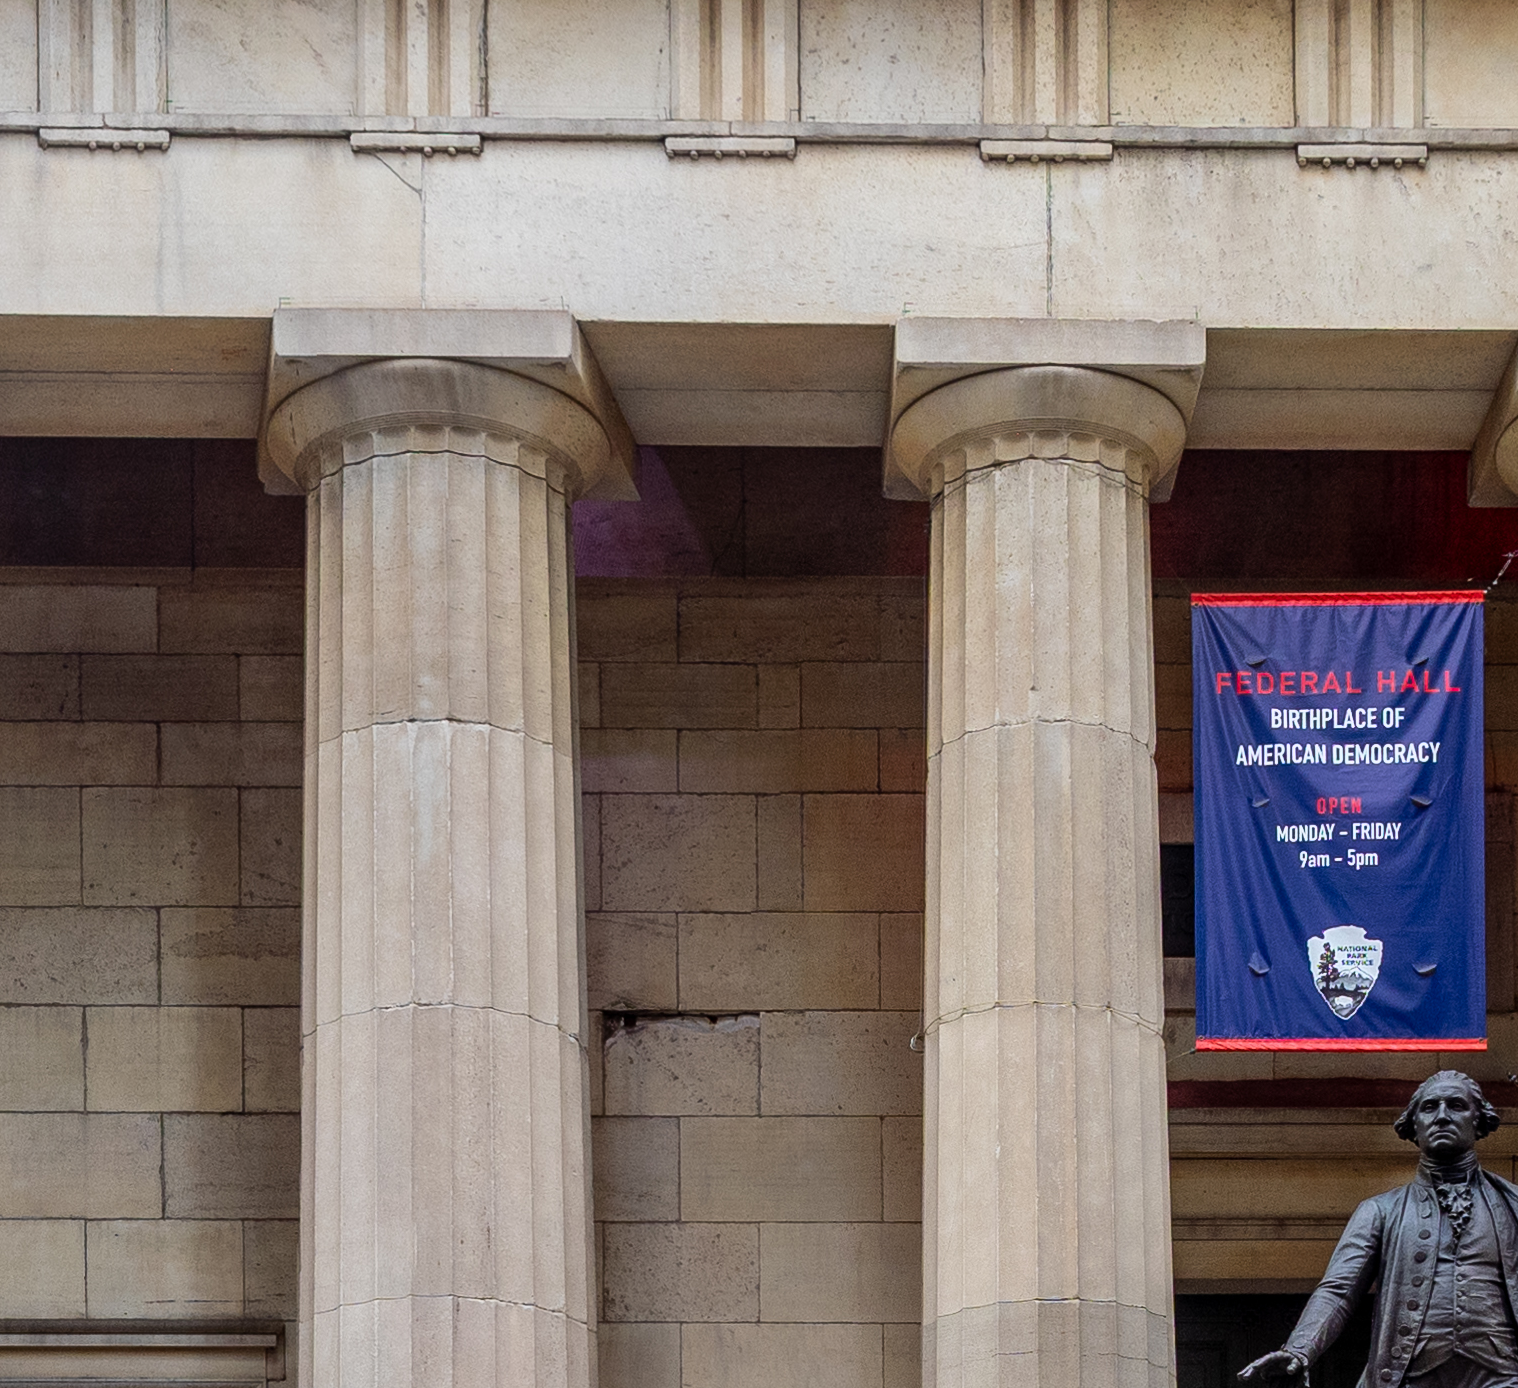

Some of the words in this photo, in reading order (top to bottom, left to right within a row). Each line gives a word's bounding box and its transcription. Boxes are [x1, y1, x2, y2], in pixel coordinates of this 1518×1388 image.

[1215, 671, 1362, 696] FEDERAL
[1377, 669, 1461, 694] HALL
[1271, 707, 1378, 730] BIRTHPLACE
[1383, 707, 1406, 729] OF
[1235, 742, 1327, 766] AMERICAN
[1332, 741, 1441, 765] DEMOCRACY
[1316, 797, 1362, 814] OPEN
[1276, 823, 1335, 842] MONDAY
[1352, 822, 1402, 840] FRIDAY
[1299, 850, 1330, 868] 9am
[1347, 849, 1379, 870] 5pm
